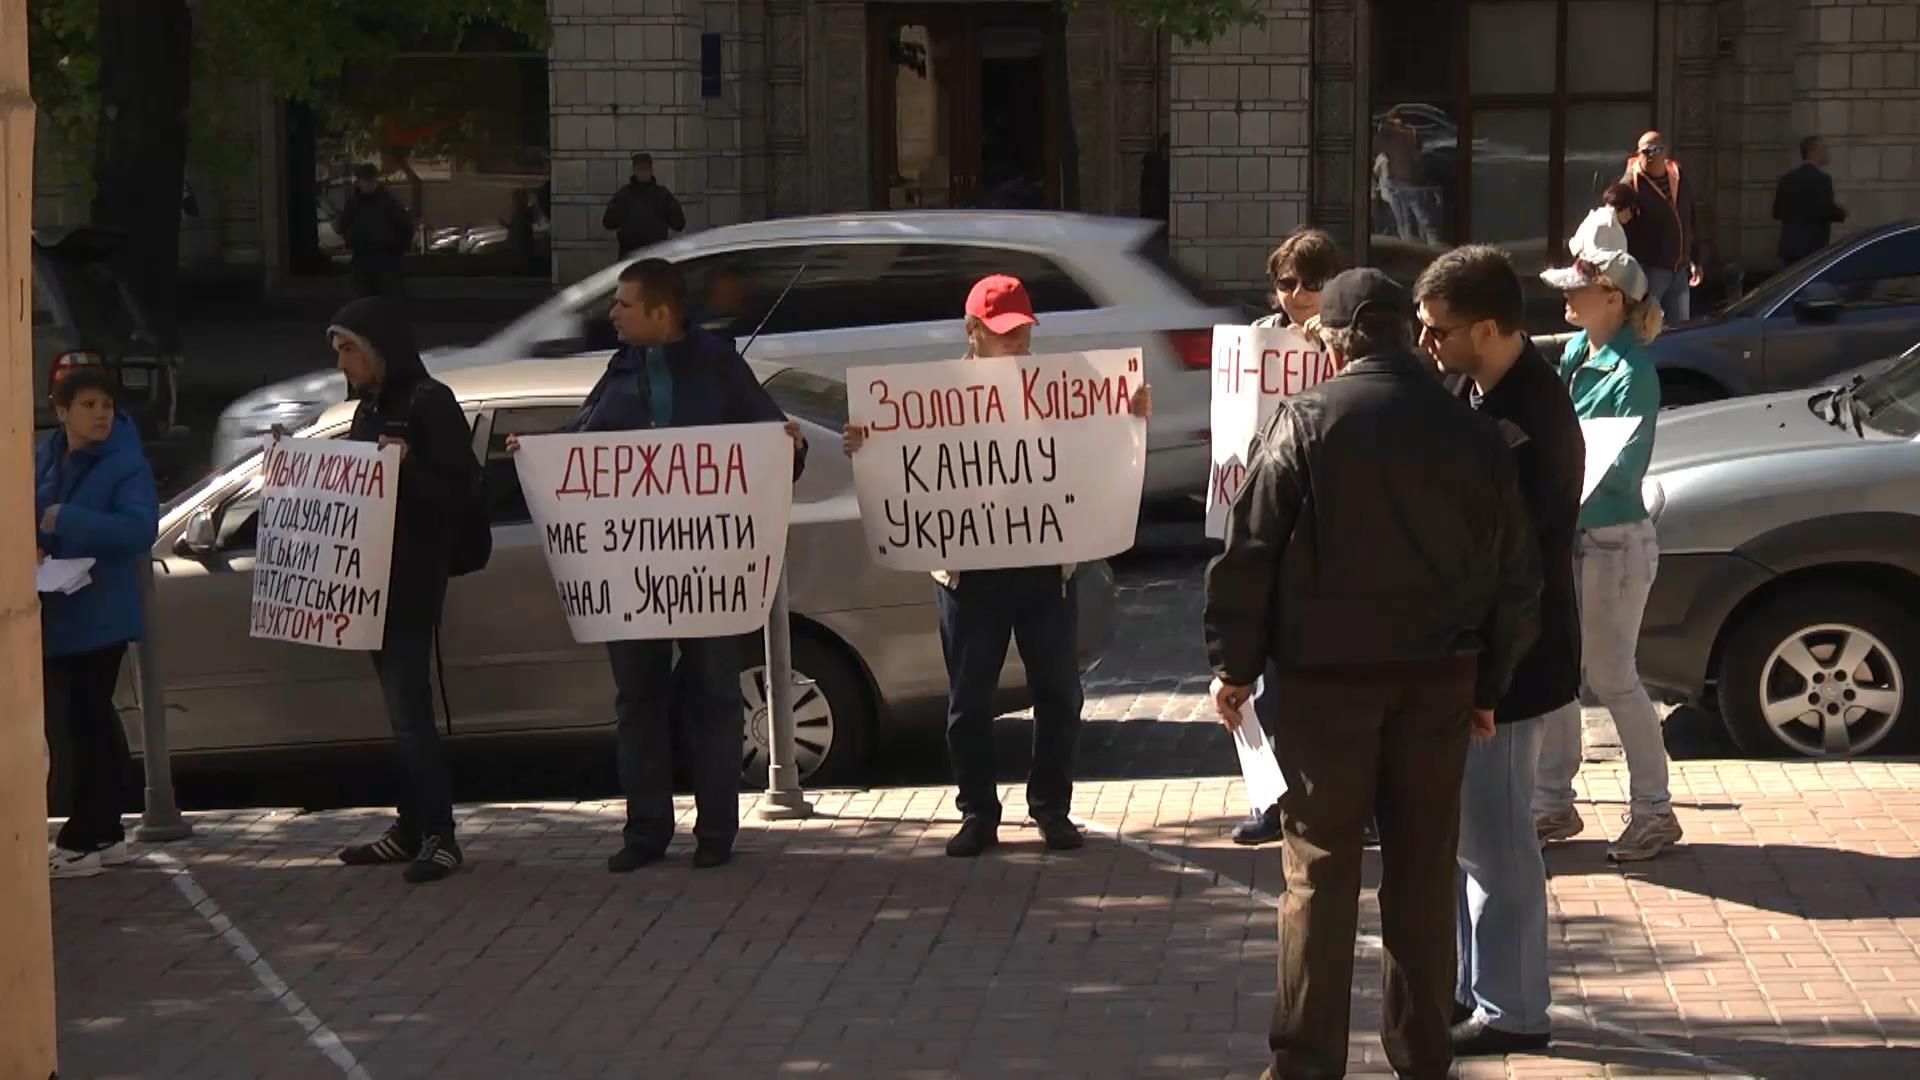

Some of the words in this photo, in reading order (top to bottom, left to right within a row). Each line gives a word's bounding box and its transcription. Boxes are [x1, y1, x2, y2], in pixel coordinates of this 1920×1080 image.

[313, 453, 384, 499] МОЖНА
[555, 442, 749, 501] ДЕРЖАВА
[901, 436, 1058, 494] КАНАЛУ
[271, 498, 359, 540] ГОДУВАТИ
[546, 522, 588, 554] МАЄ
[603, 513, 756, 553] ЗУПИНИТИ
[333, 544, 361, 580] ТА
[558, 578, 612, 617] АНАЛ
